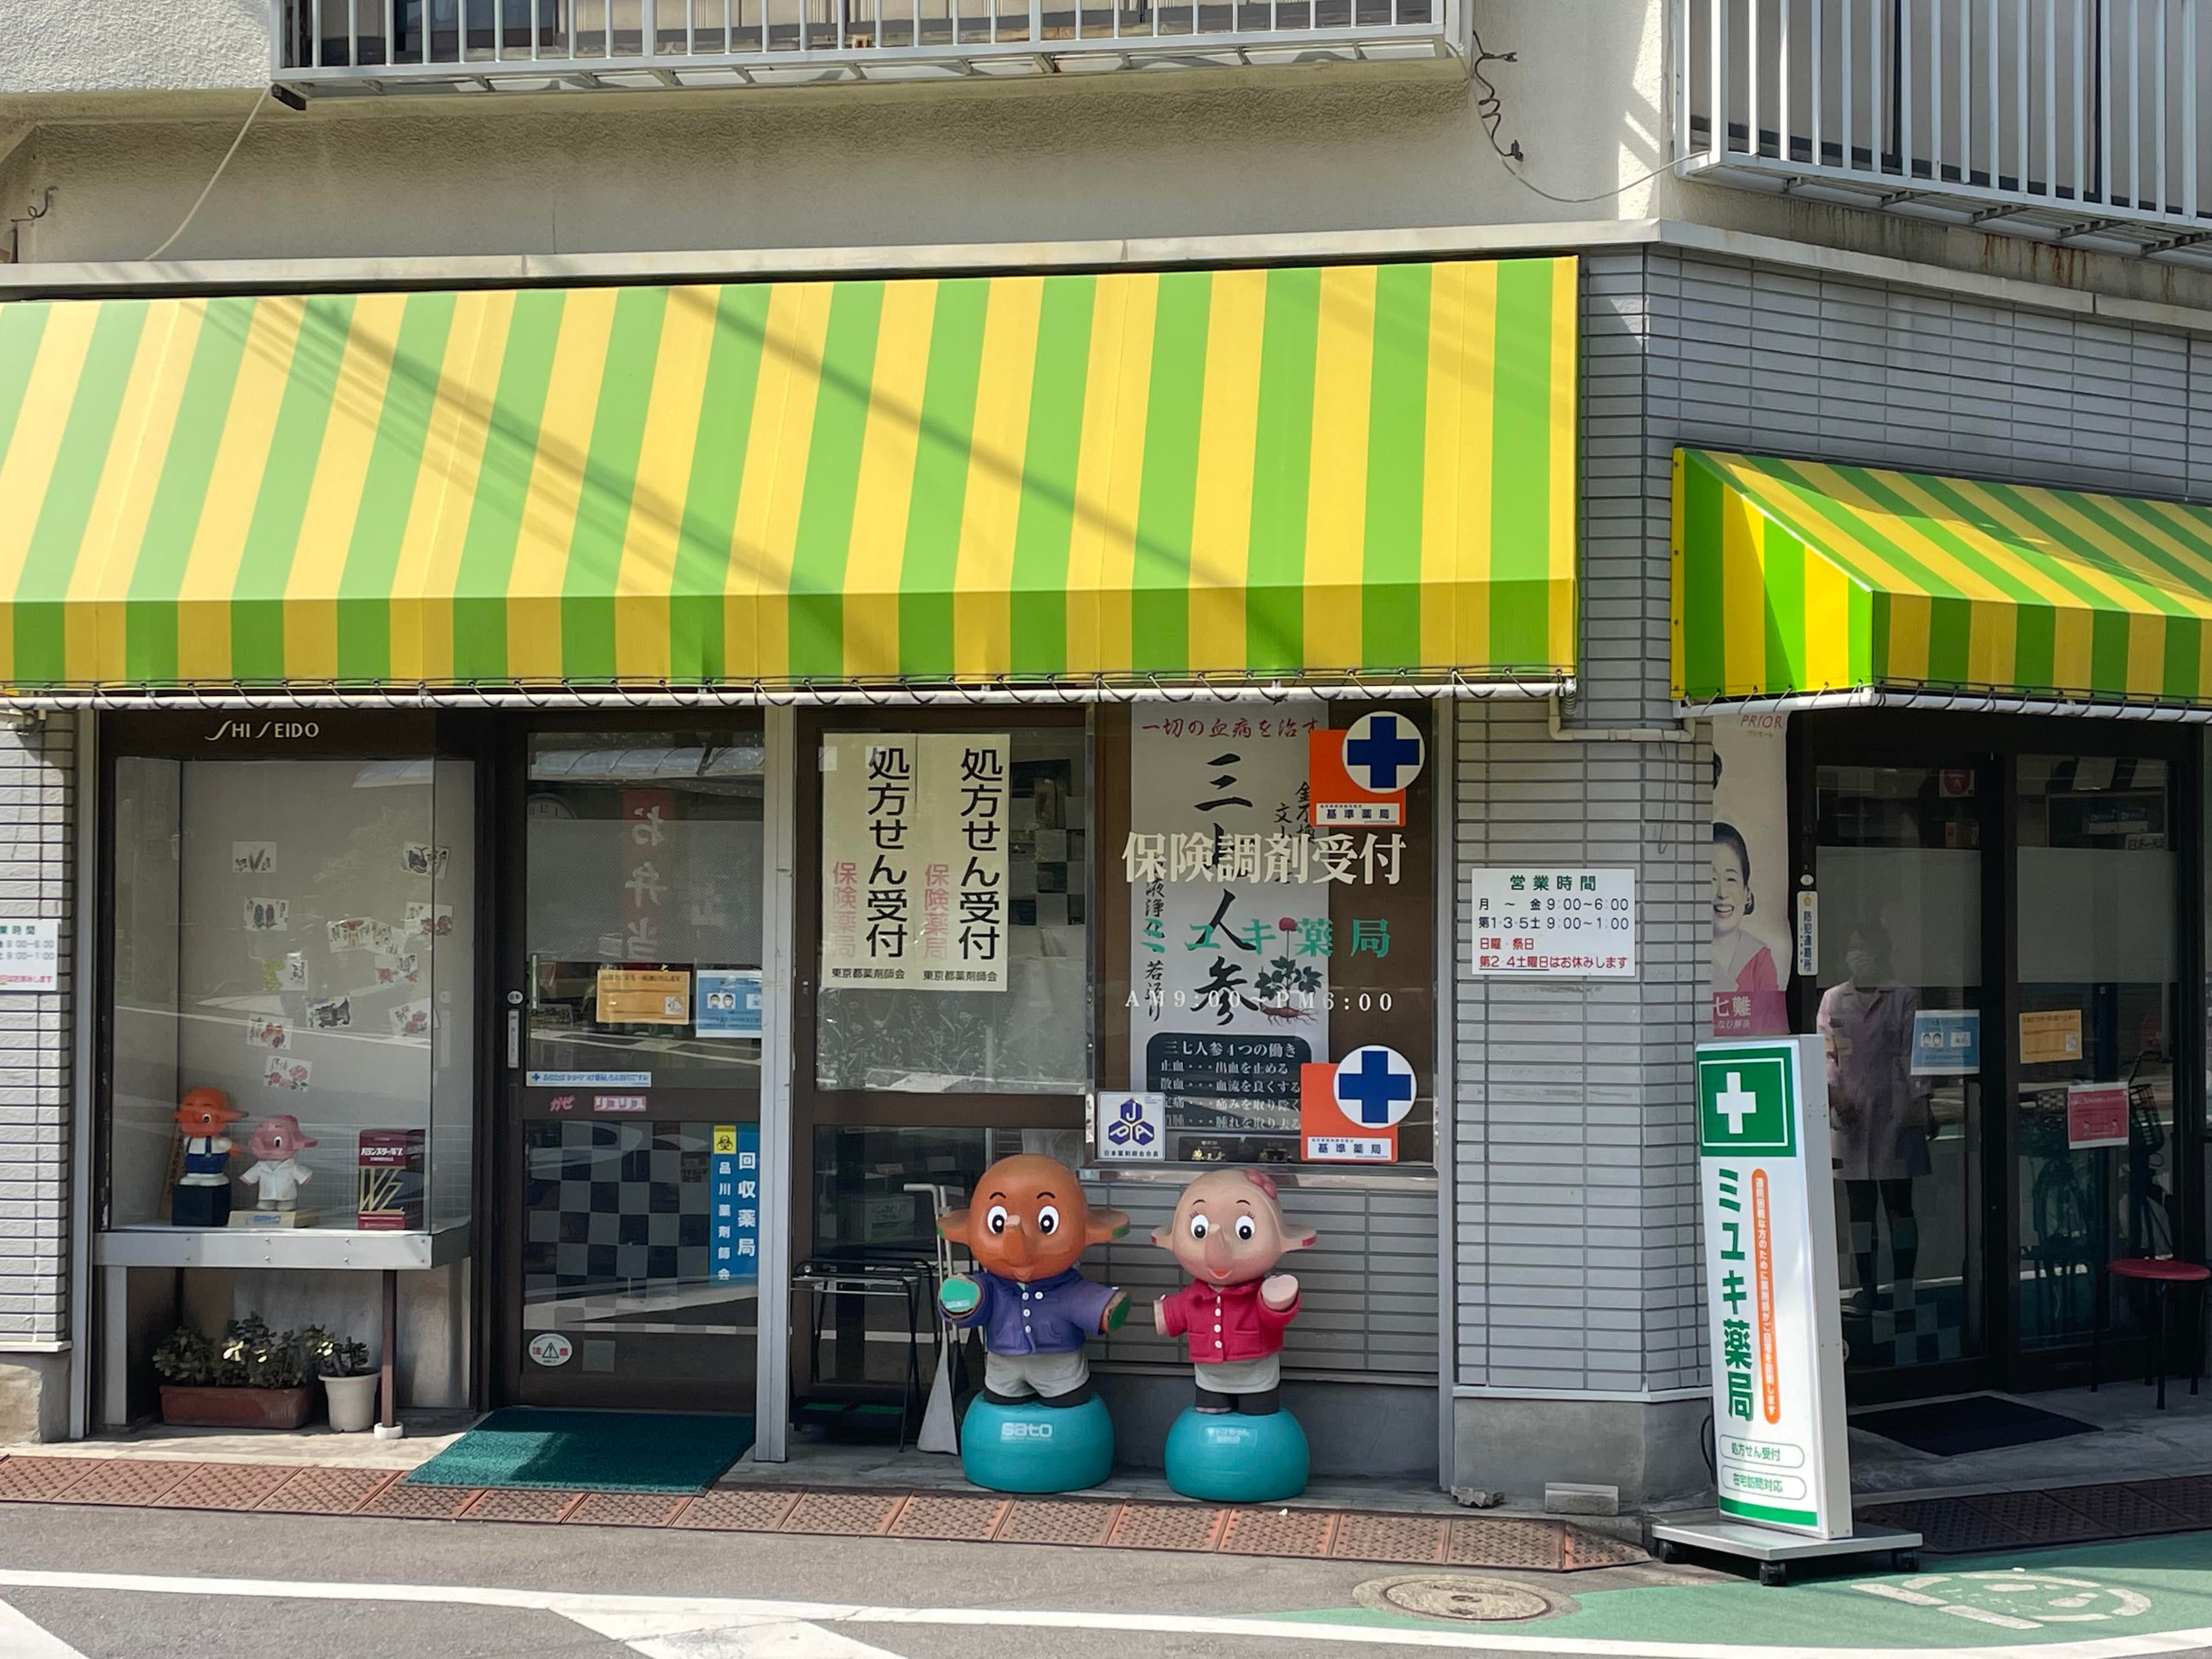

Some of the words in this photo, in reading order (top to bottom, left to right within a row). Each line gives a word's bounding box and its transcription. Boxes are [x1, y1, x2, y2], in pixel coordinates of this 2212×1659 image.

[1741, 715, 1783, 729] PRIOR
[1327, 809, 1390, 820] 基準薬局
[866, 747, 910, 958] 処方せん受付
[958, 748, 1003, 960] 処方せん受付
[1121, 831, 1407, 885] 保険調剤受付
[1510, 874, 1596, 891] 営業時間
[832, 862, 857, 958] 保険薬局
[924, 864, 949, 960] 保険薬局
[1141, 917, 1392, 959] ミユキ薬局
[831, 968, 906, 979] 東京都薬剤師会
[923, 970, 998, 982] 東京都薬剤師会
[1713, 995, 1752, 1017] 七難
[1164, 1041, 1297, 1058] 三七人参4つの働き
[549, 1094, 577, 1112] かぜ
[595, 1096, 646, 1111] リコリス
[1318, 1143, 1381, 1154] 基準薬局
[737, 1152, 756, 1257] 回収薬局
[717, 1161, 732, 1281] 品川薬剤師会
[1719, 1168, 1753, 1423] ミユキ薬局
[1731, 1442, 1782, 1463] 処方せん受付
[1733, 1472, 1784, 1493] 在宅訪問対応
